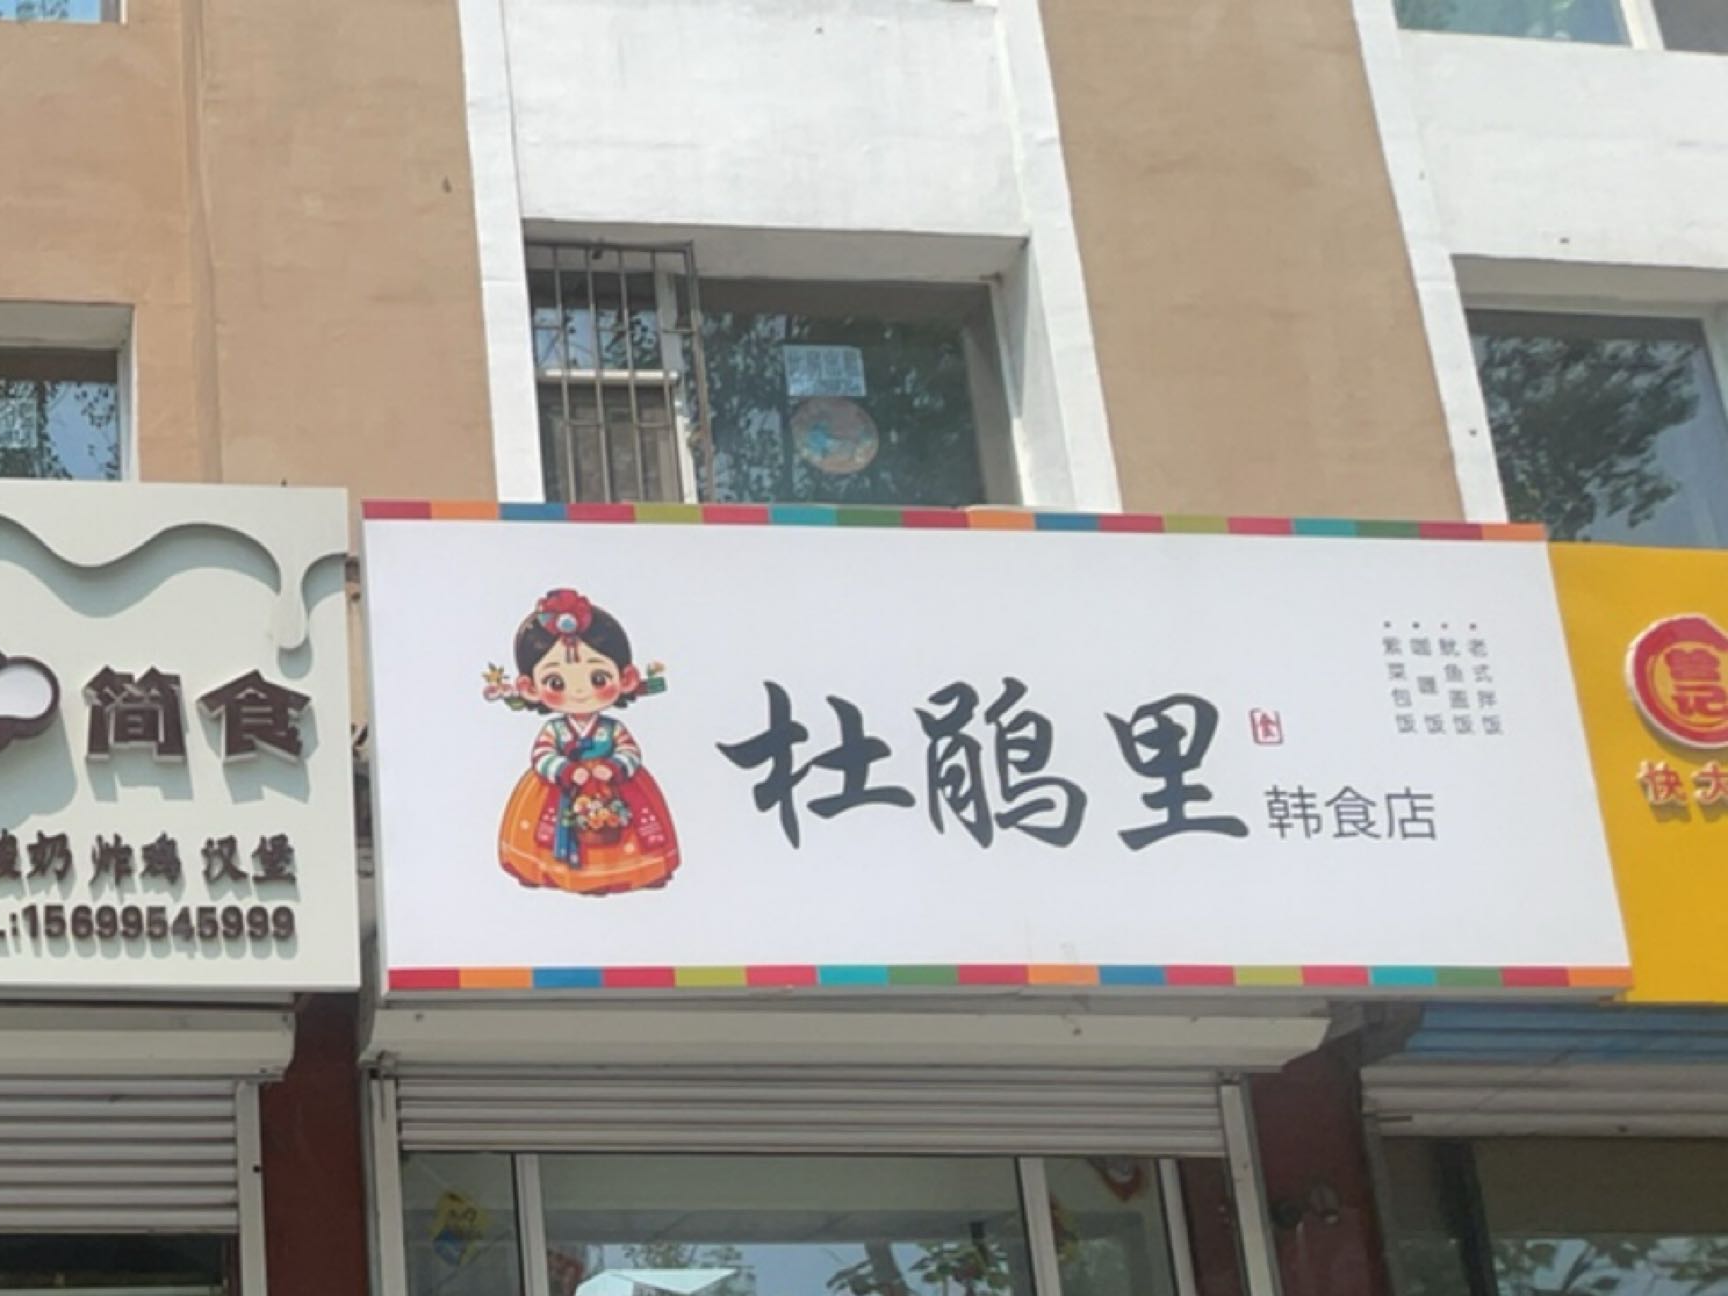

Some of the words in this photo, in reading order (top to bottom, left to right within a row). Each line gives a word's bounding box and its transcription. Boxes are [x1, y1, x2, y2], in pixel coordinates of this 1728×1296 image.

[83, 665, 312, 764] 简食
[715, 677, 1249, 851] 杜鹃里
[1264, 784, 1437, 840] 韩食店
[88, 832, 183, 886] 炸鸡
[200, 832, 299, 885] 汉堡
